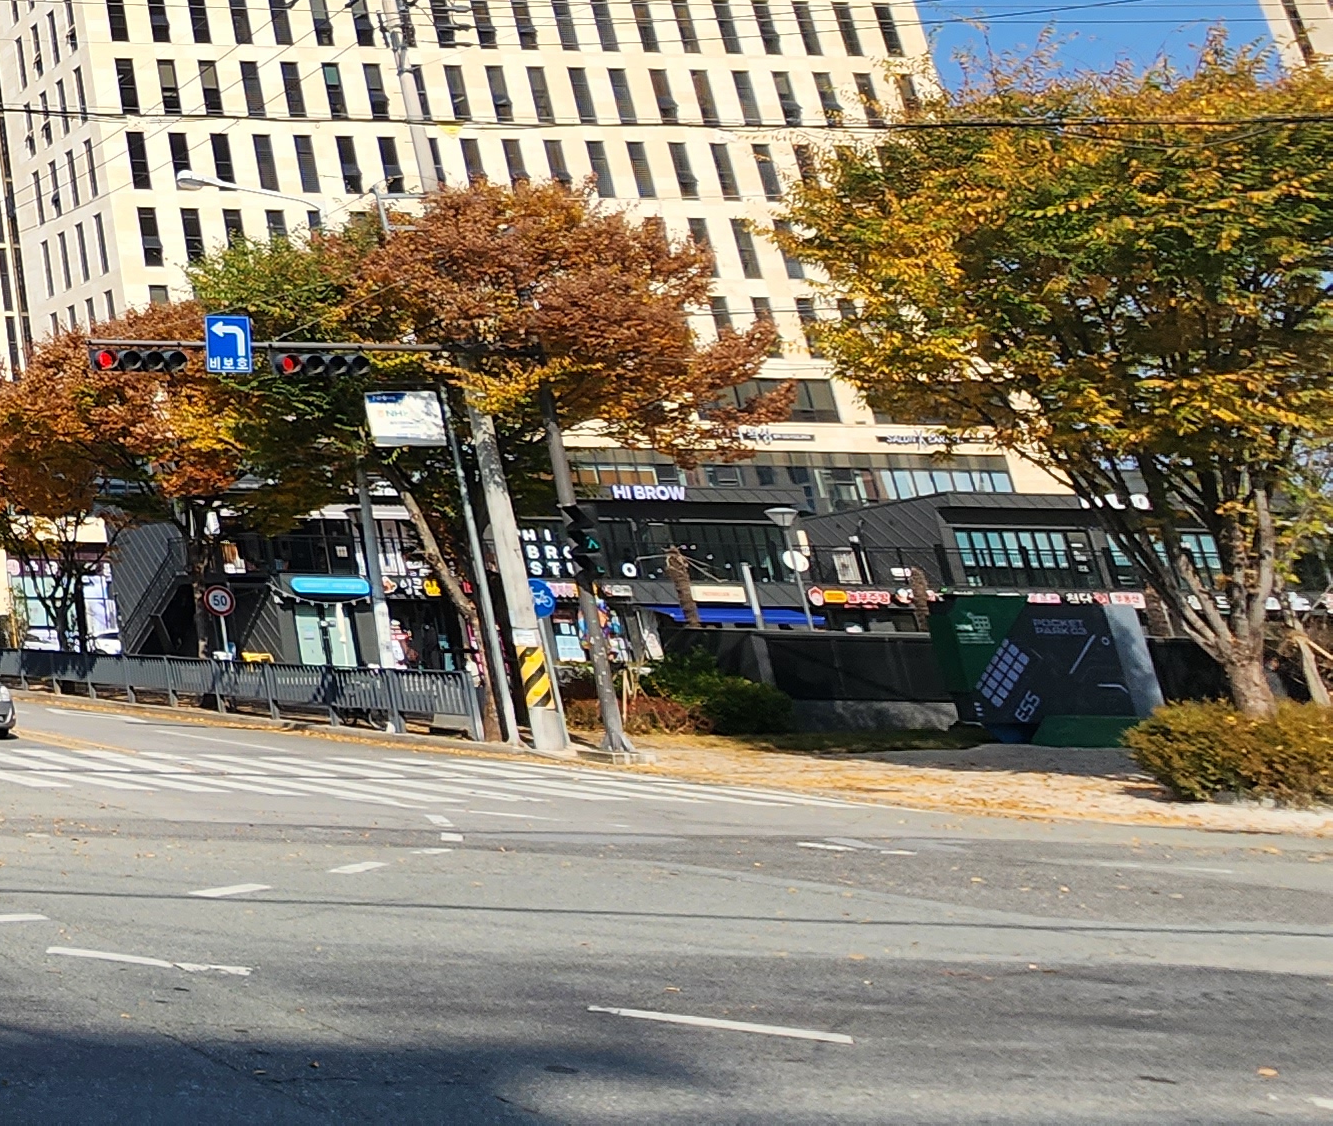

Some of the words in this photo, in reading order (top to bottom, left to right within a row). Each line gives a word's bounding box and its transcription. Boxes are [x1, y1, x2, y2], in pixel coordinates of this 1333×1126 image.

[209, 356, 249, 370] 비보호
[612, 485, 632, 500] HI
[633, 485, 686, 501] BROW
[212, 594, 228, 607] 50
[1032, 618, 1084, 628] POCKET
[1035, 626, 1070, 635] PARK
[1014, 690, 1042, 723] ESS
